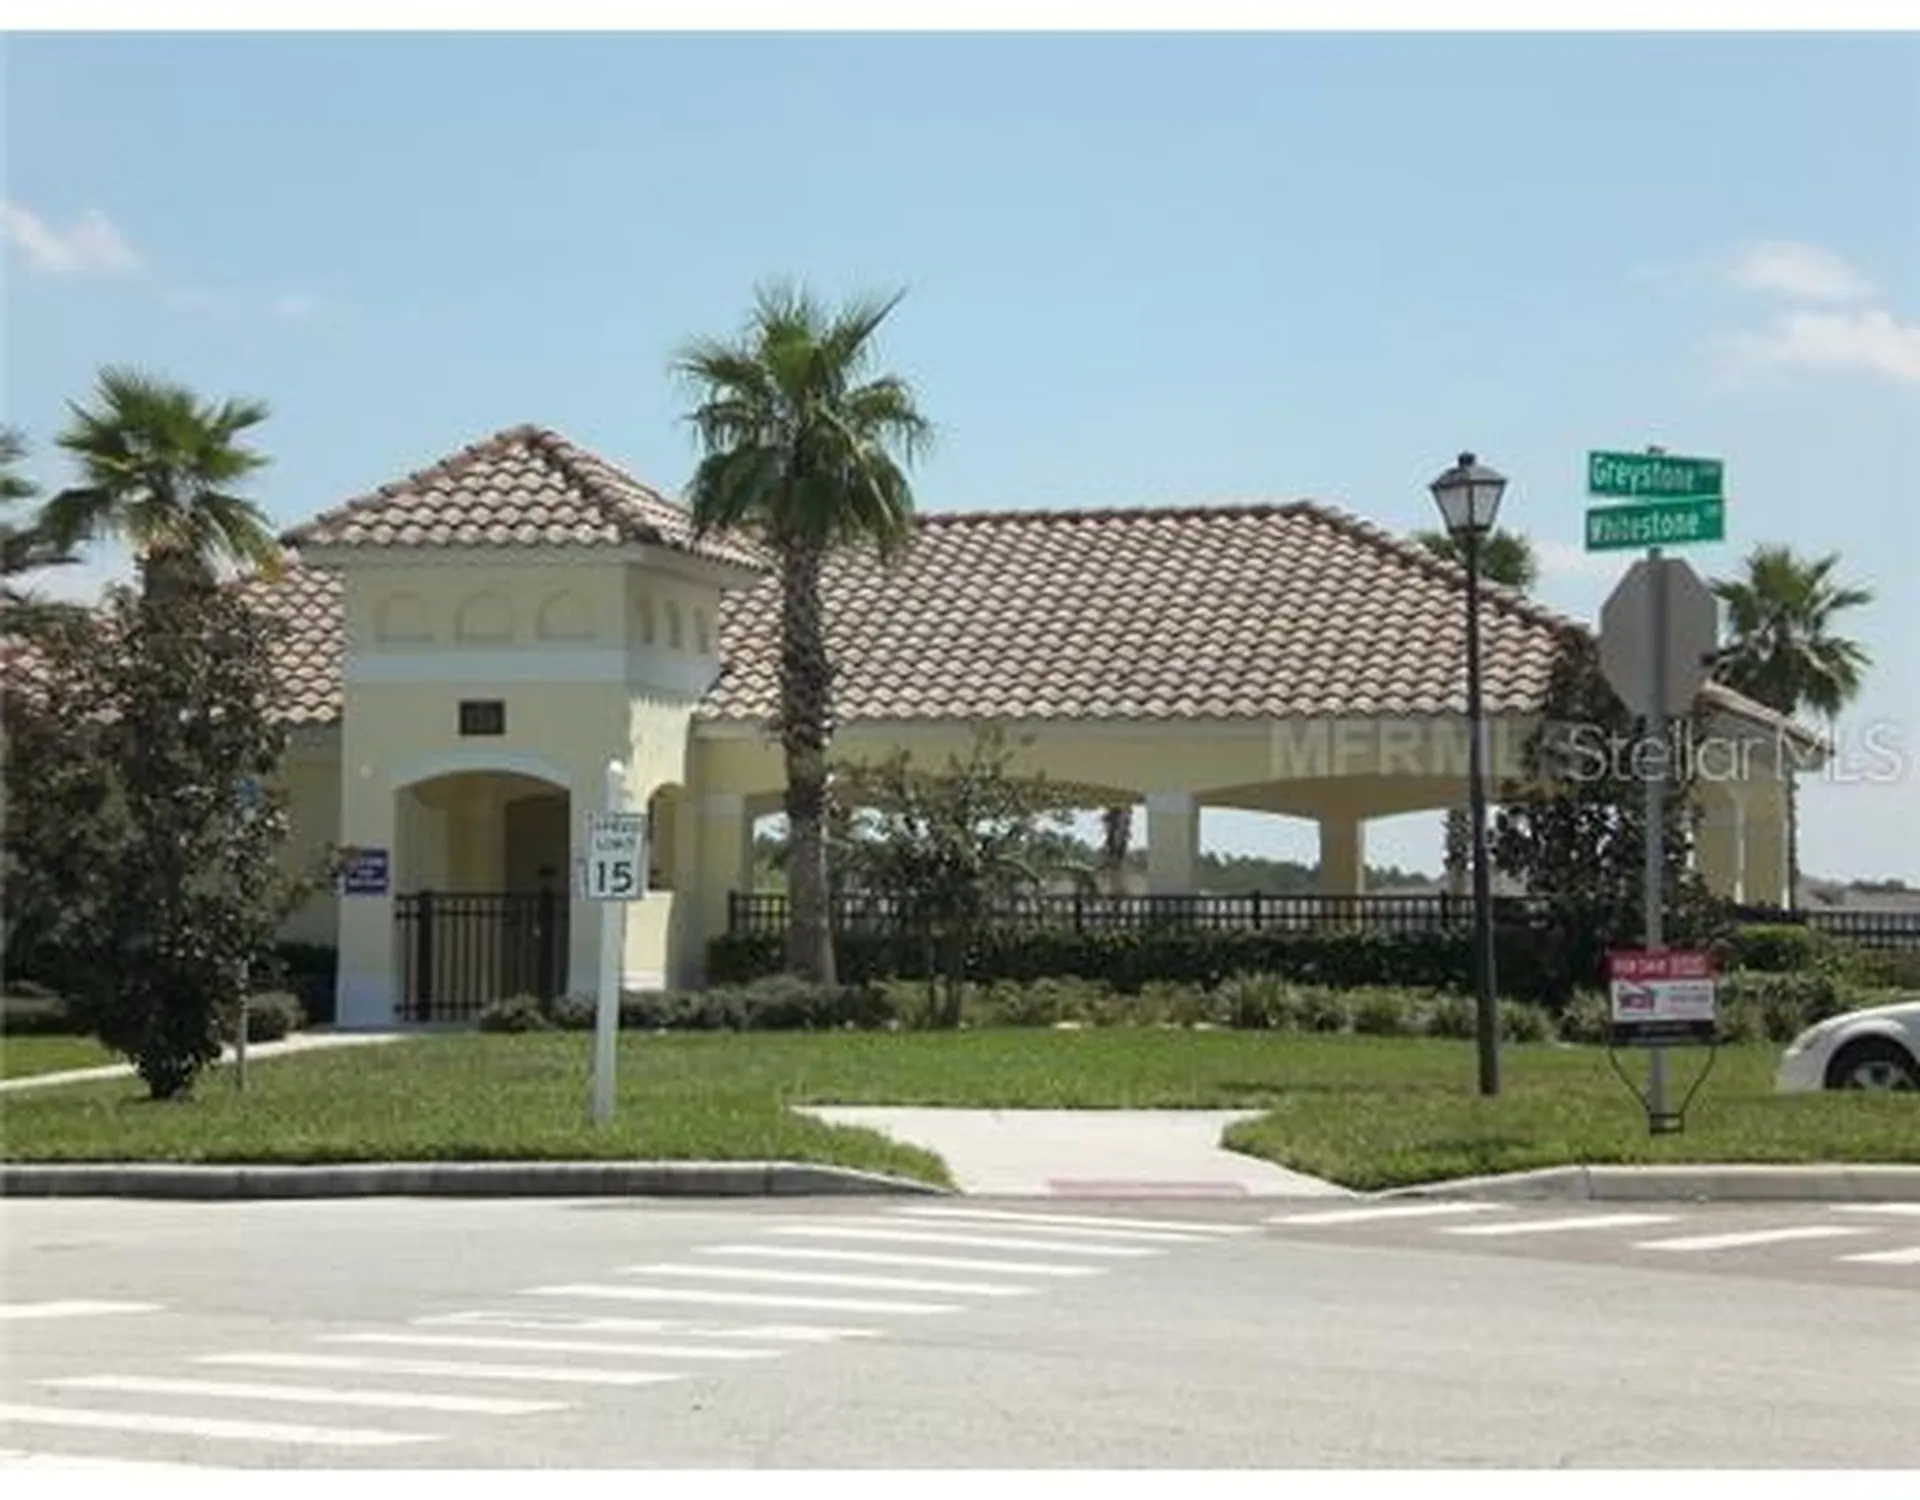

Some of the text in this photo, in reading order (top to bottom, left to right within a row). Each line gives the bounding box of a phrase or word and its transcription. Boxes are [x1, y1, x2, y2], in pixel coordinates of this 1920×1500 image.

[1592, 456, 1695, 493] Greystone
[1590, 509, 1700, 542] Whitestone
[597, 860, 634, 893] 15
